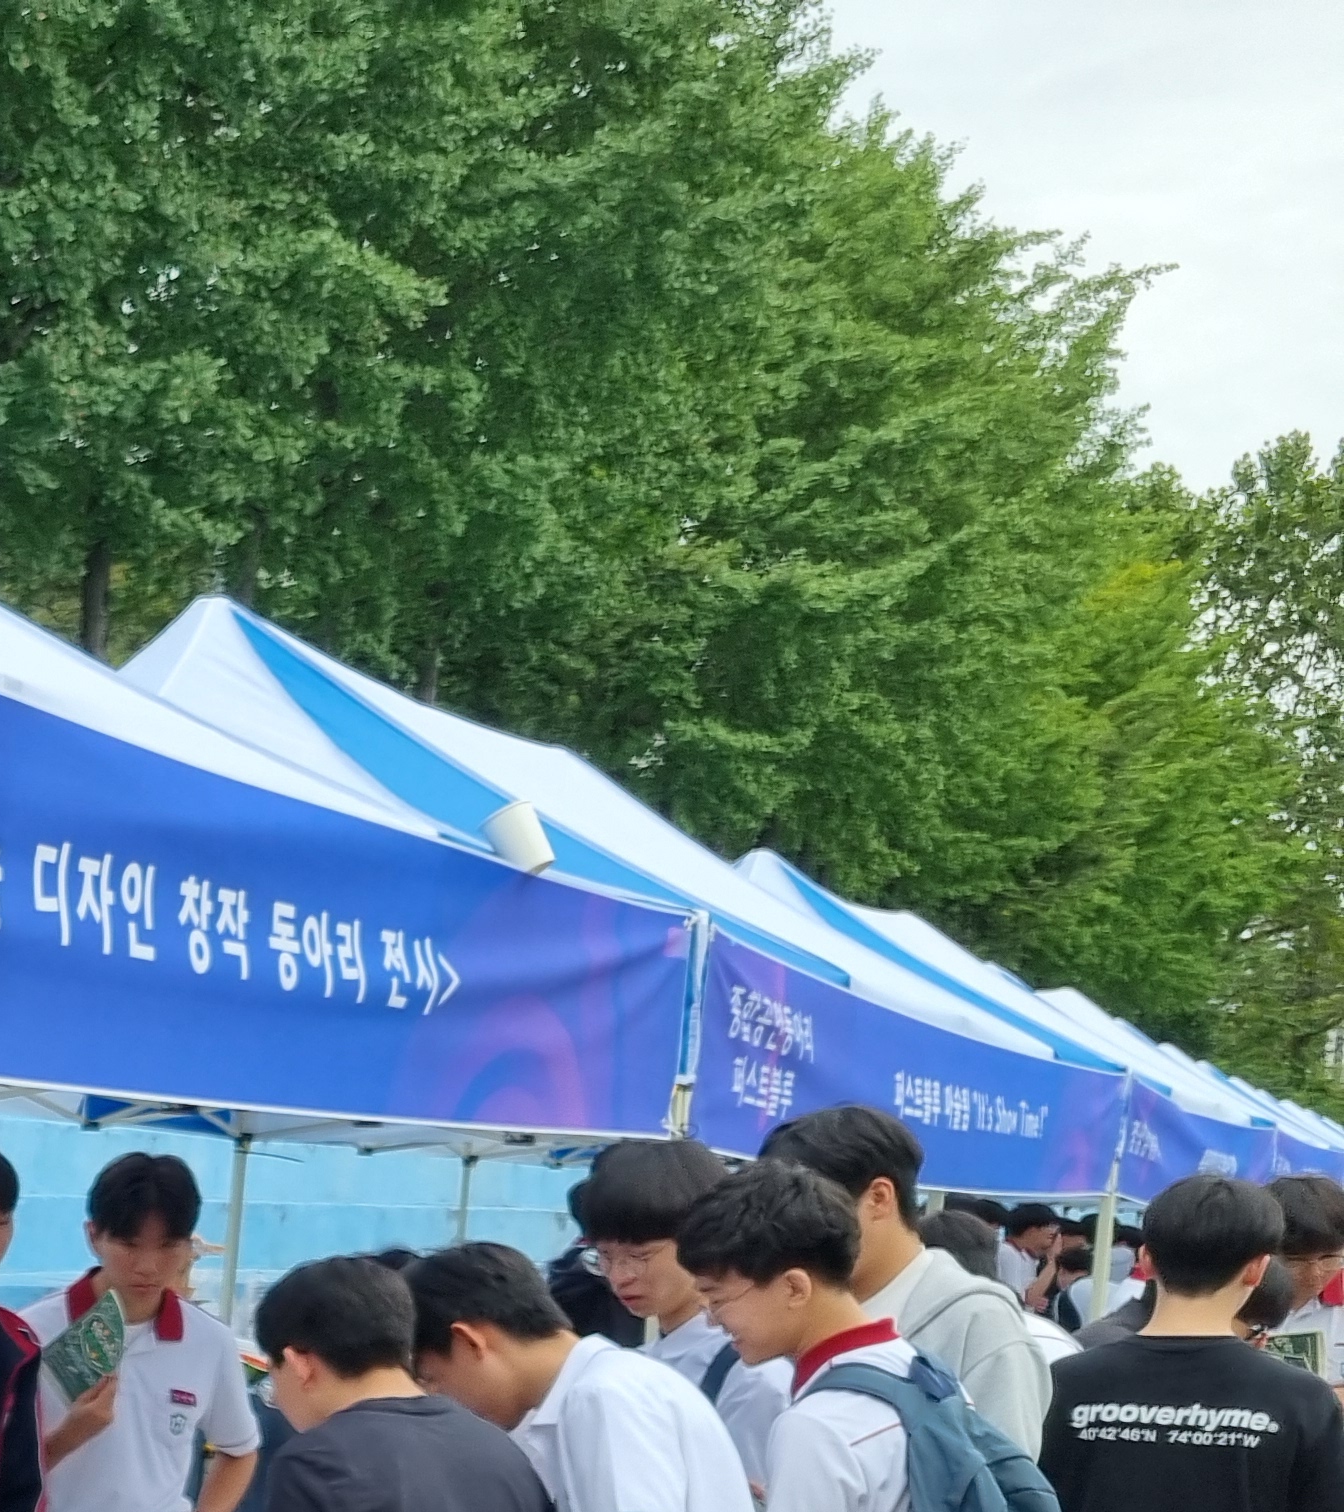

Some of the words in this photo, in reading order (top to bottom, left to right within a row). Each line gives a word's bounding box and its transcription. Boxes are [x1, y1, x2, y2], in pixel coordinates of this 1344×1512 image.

[32, 841, 157, 962] 디자인
[178, 874, 251, 981] 창작
[267, 900, 367, 1005] 동아리
[380, 928, 463, 1017] 전시>
